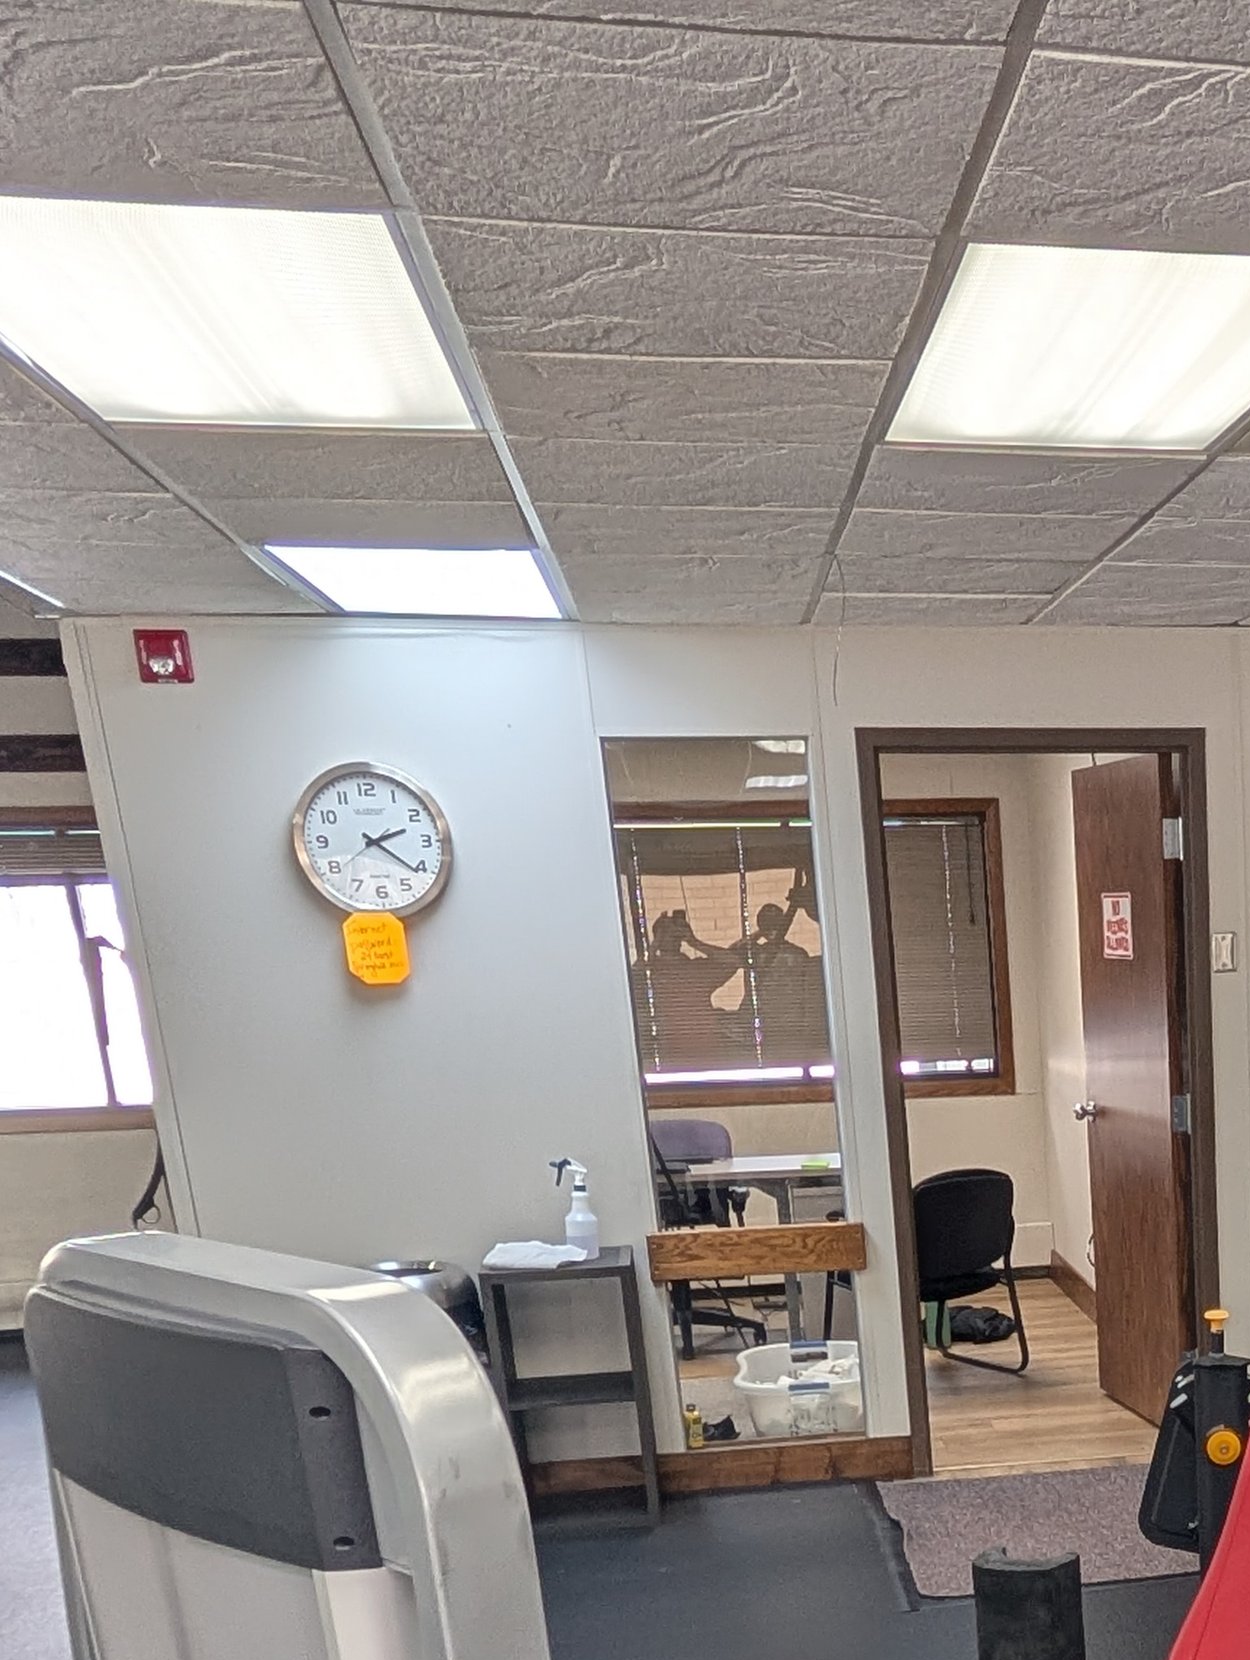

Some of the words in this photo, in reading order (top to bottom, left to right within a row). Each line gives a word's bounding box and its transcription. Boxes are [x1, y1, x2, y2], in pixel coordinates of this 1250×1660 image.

[357, 782, 376, 797] 12
[390, 789, 397, 804] 1
[337, 791, 349, 805] 11
[320, 809, 337, 825] 10
[407, 808, 422, 823] 2
[316, 834, 329, 849] 9
[420, 834, 433, 848] 3
[328, 860, 342, 874] 8
[414, 859, 427, 874] 4
[351, 878, 364, 893] 7
[375, 885, 389, 899] 6
[400, 877, 413, 892] 5
